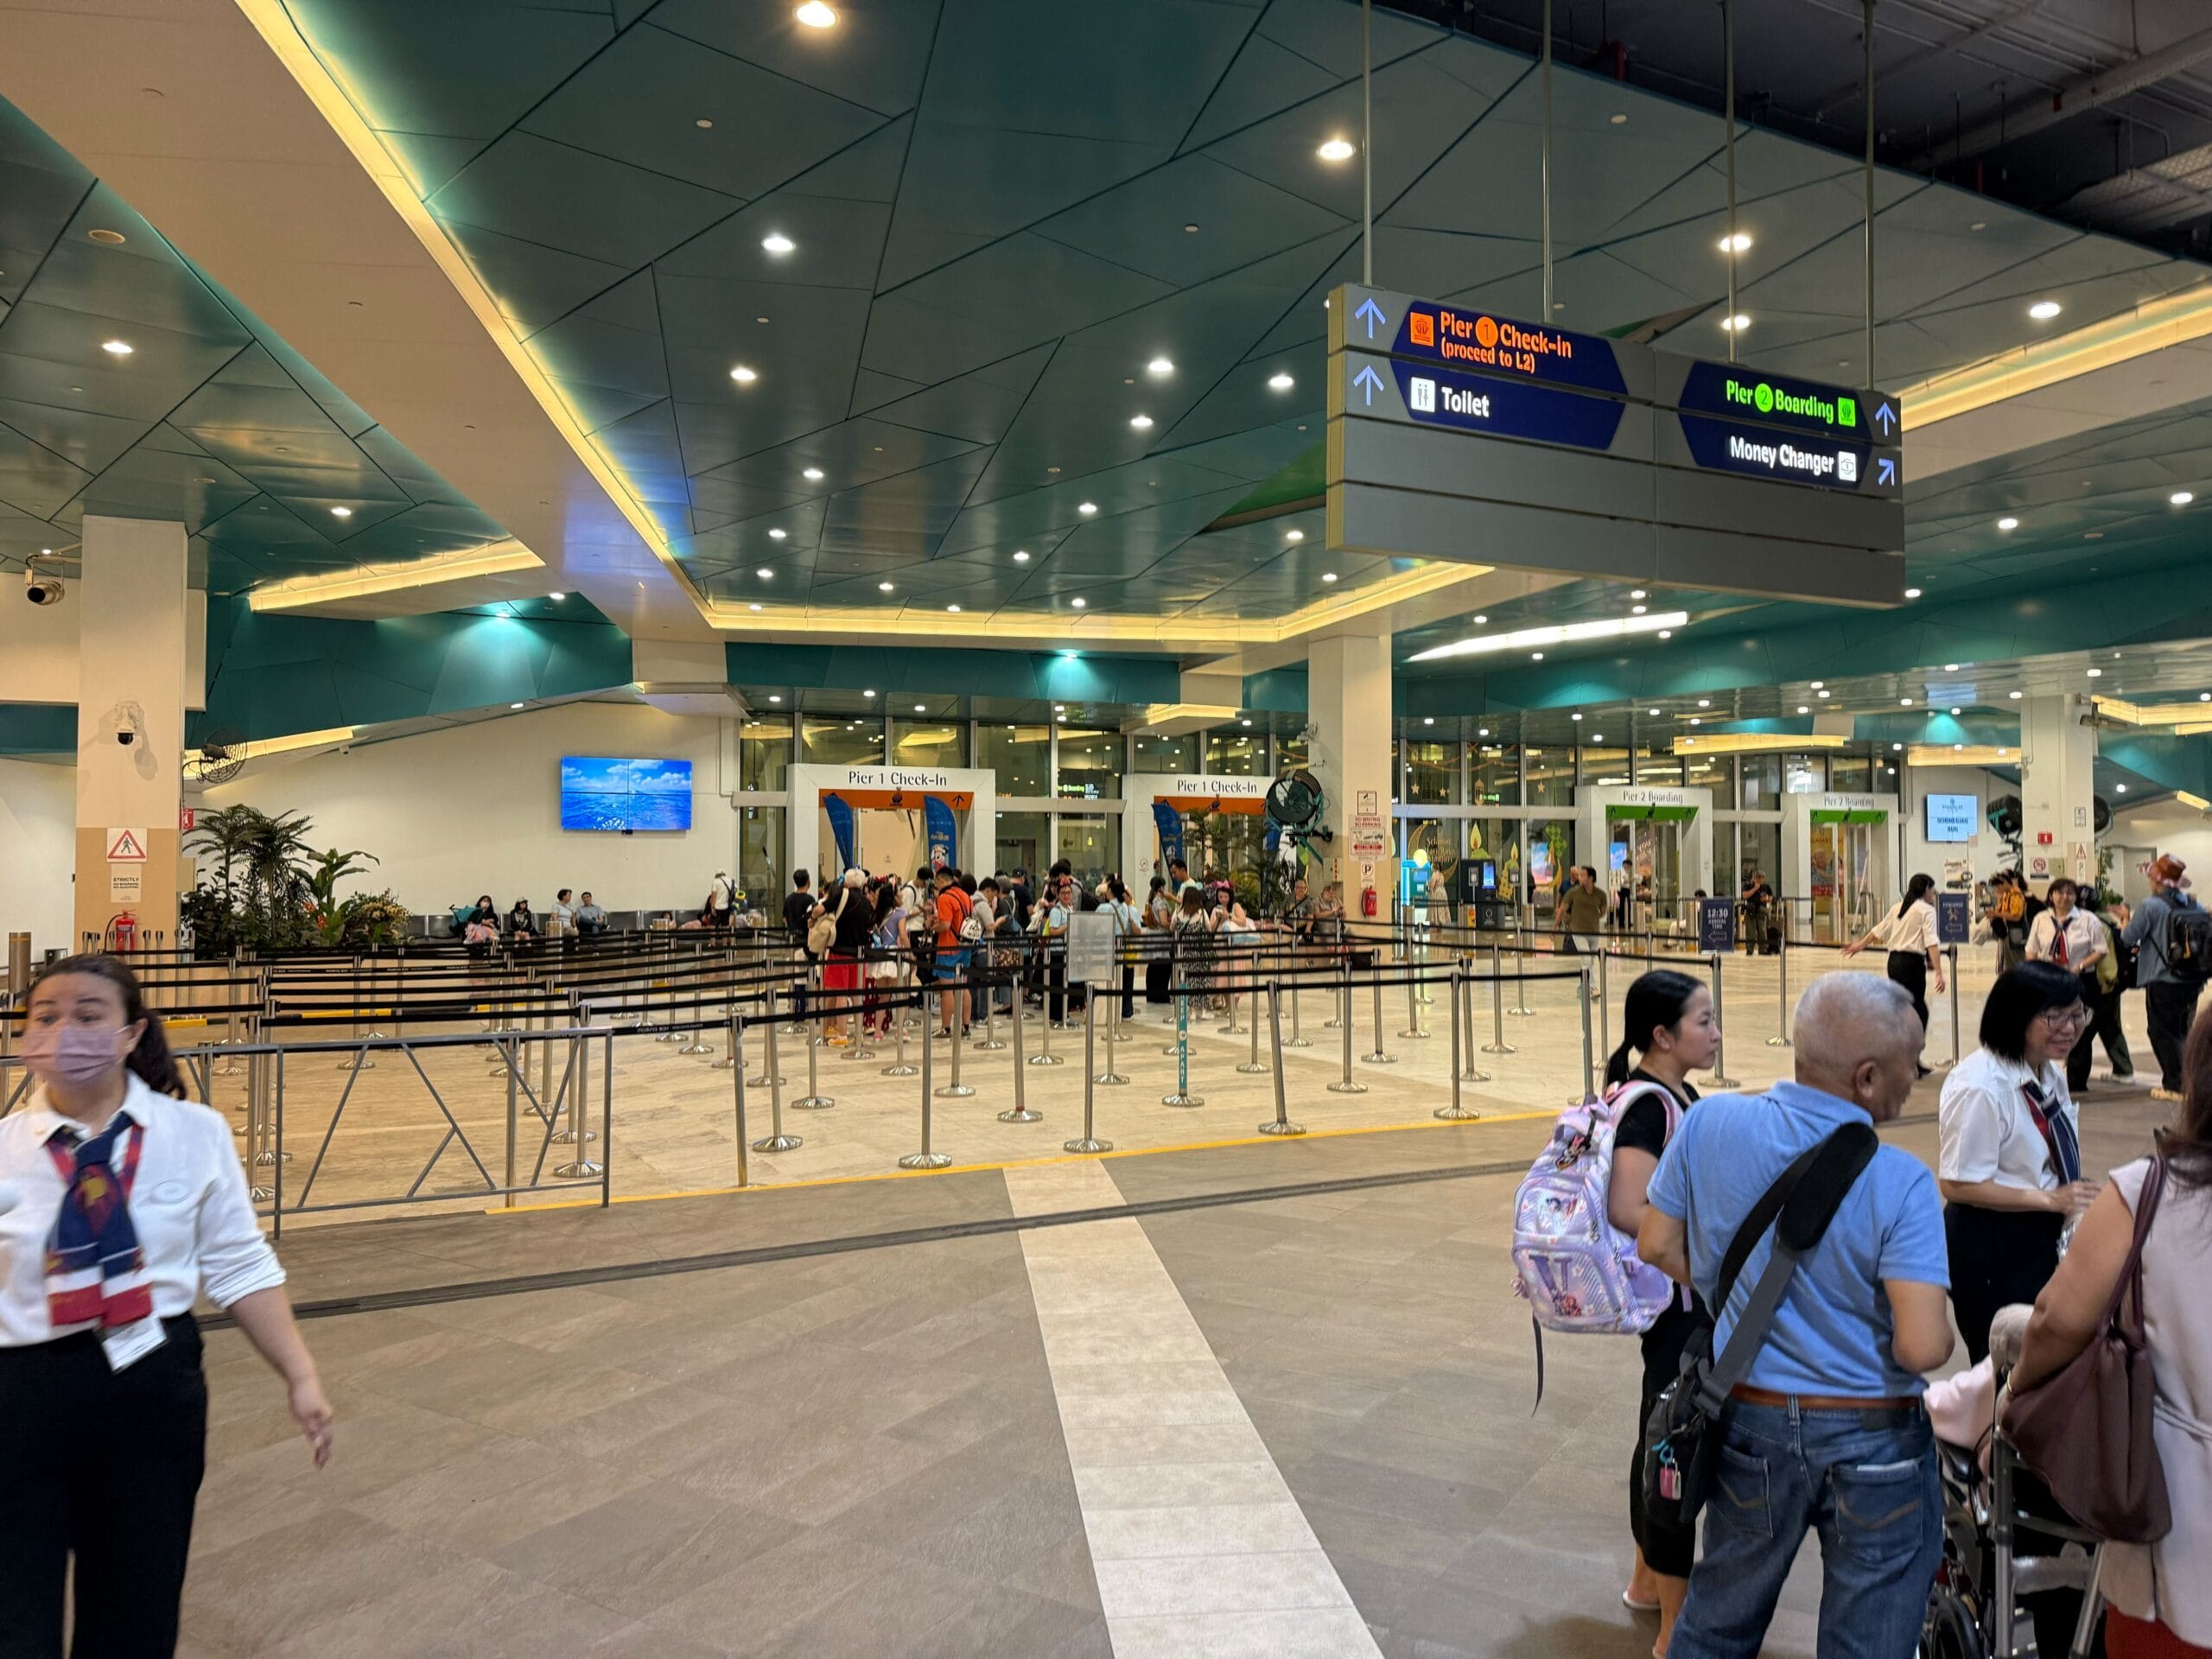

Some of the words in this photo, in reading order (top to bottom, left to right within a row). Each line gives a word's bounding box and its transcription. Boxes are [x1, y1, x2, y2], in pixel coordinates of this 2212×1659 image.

[1440, 311, 1472, 339] Pier
[1499, 323, 1572, 359] Check-in
[1441, 336, 1495, 365] (proceed
[1499, 349, 1512, 368] to
[1516, 351, 1535, 374] L2)
[1441, 386, 1490, 417] Toilet
[1726, 379, 1753, 405] Pier
[1775, 389, 1834, 424] Boarding
[1730, 435, 1777, 469] Money
[1779, 443, 1834, 476] Changer
[849, 771, 874, 785] Pier
[879, 772, 884, 785] 1
[891, 772, 947, 786] Check-In
[1178, 779, 1198, 792] Pier
[1202, 780, 1206, 792] 1
[1211, 780, 1257, 793] Check-In
[1624, 790, 1637, 802] Pier
[1641, 791, 1646, 802] 2
[1649, 790, 1683, 804] Boarding
[1824, 795, 1836, 806] Pier
[1846, 796, 1874, 810] Boarding
